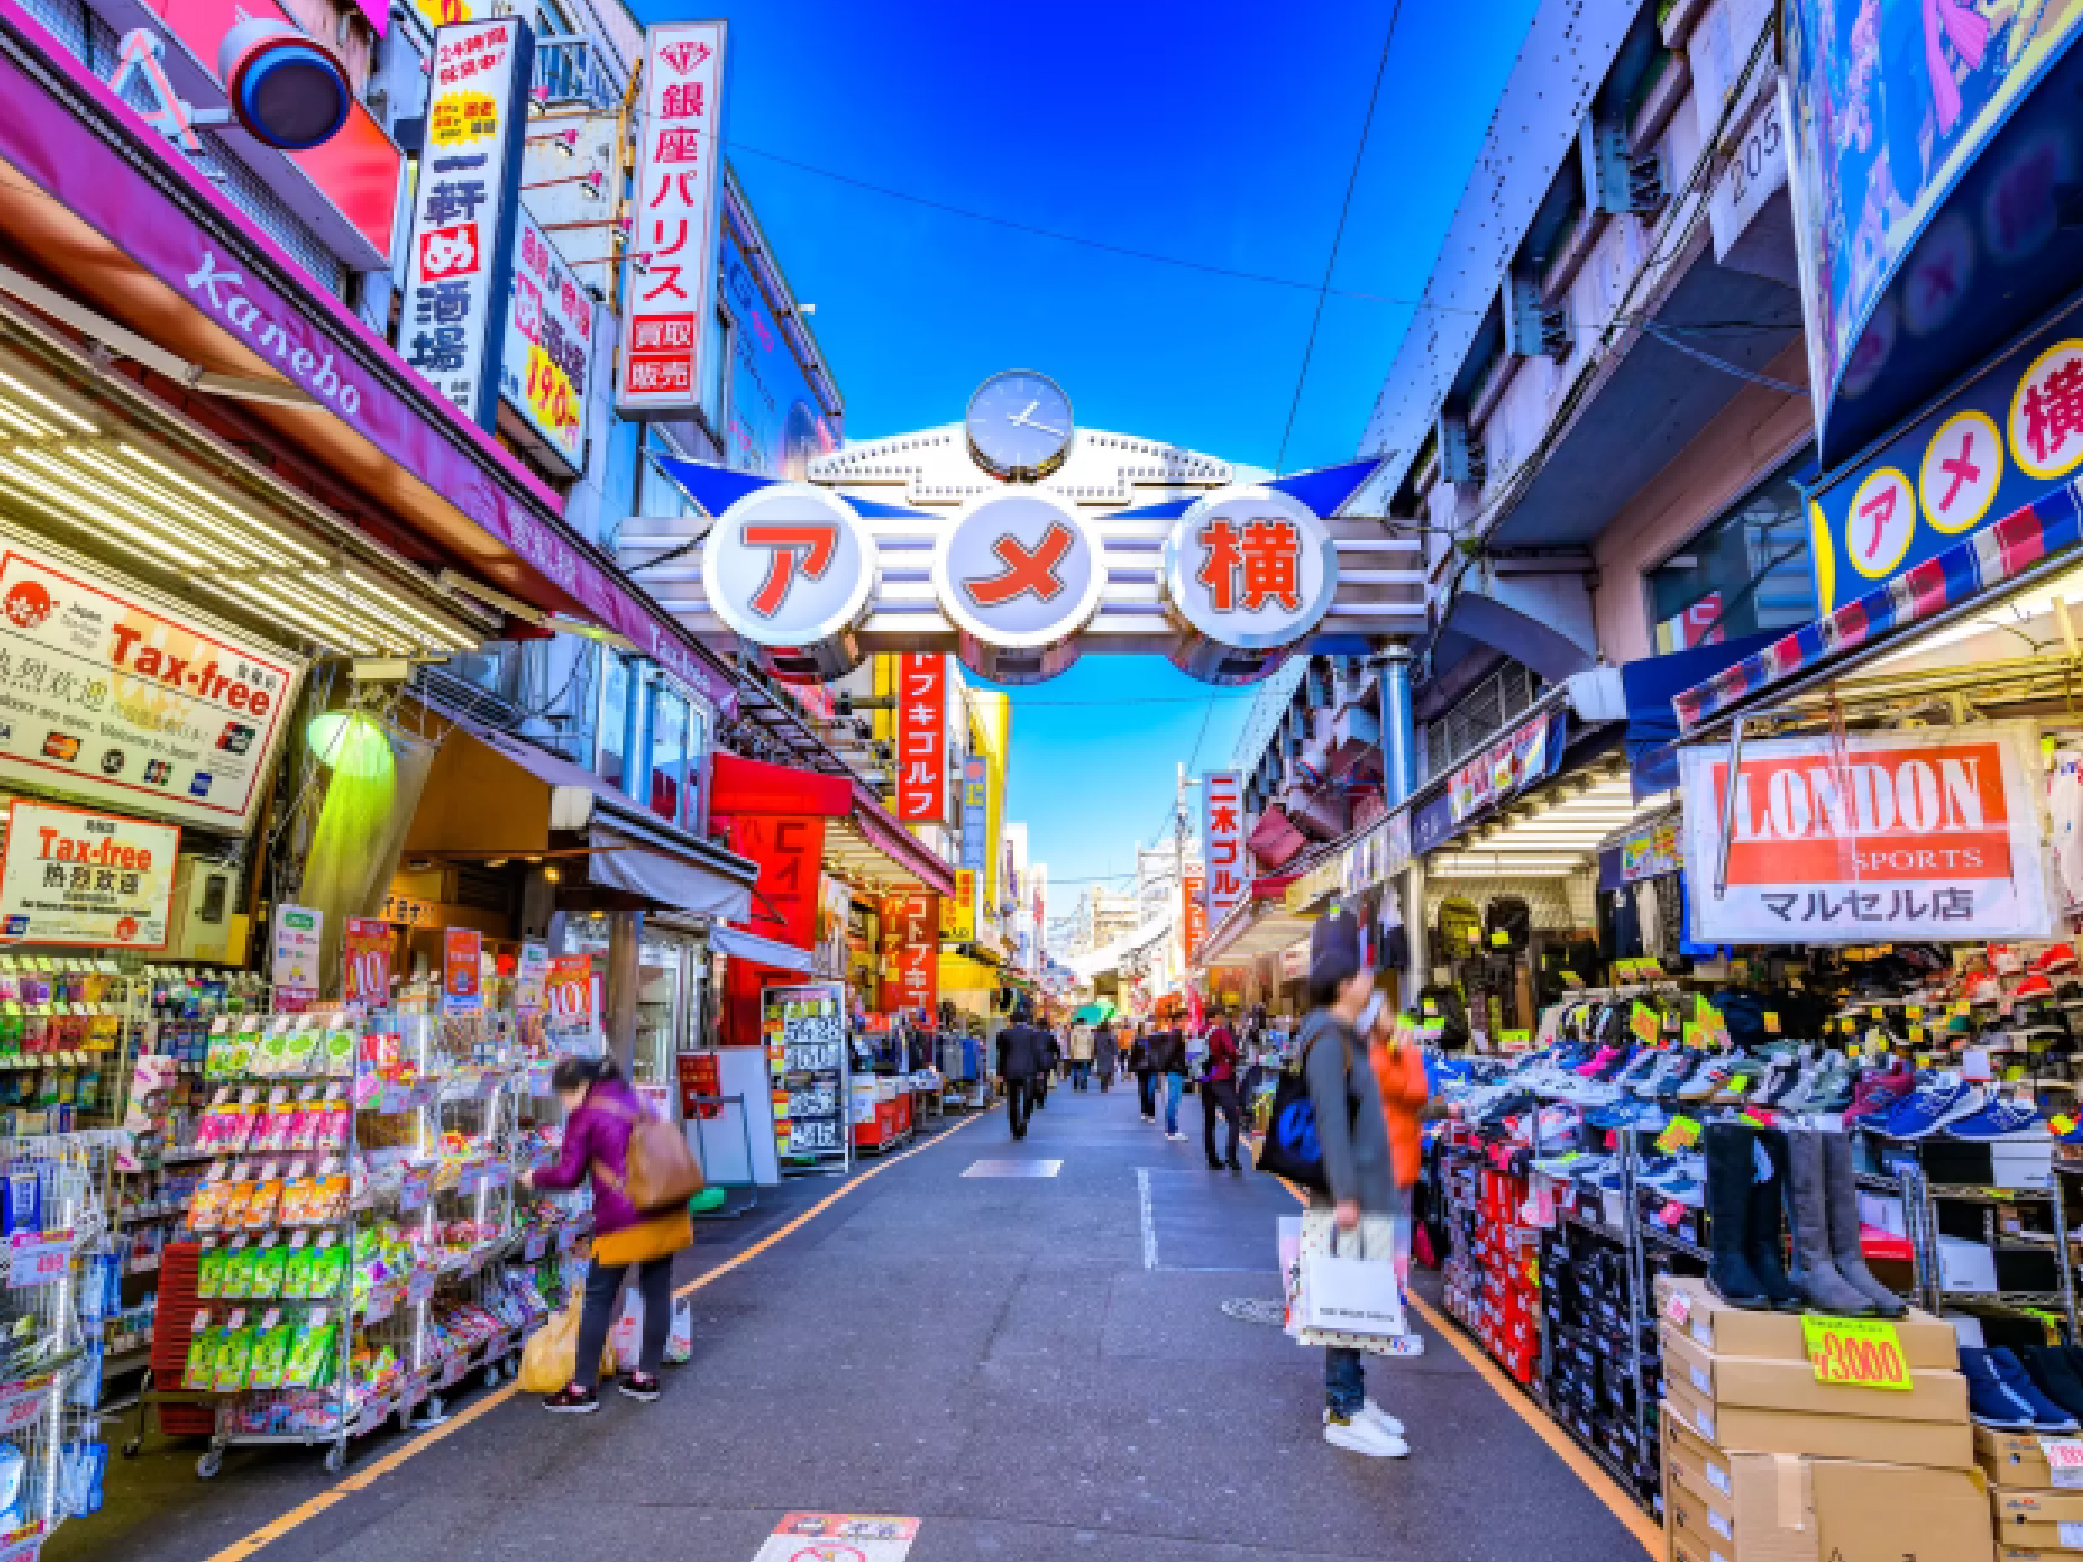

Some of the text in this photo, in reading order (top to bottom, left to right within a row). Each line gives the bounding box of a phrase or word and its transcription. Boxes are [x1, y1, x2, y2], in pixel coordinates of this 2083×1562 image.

[642, 81, 704, 301] 銀座パリス
[184, 252, 362, 414] Kanebo
[741, 516, 1302, 613] アメ横
[110, 622, 271, 716] Tax-free
[1208, 776, 1240, 907] 二木ゴル
[1732, 757, 1984, 839] LONDON
[38, 826, 152, 871] Tax-free
[1853, 847, 1984, 872] SPORTS
[1760, 887, 1974, 922] マルセル店
